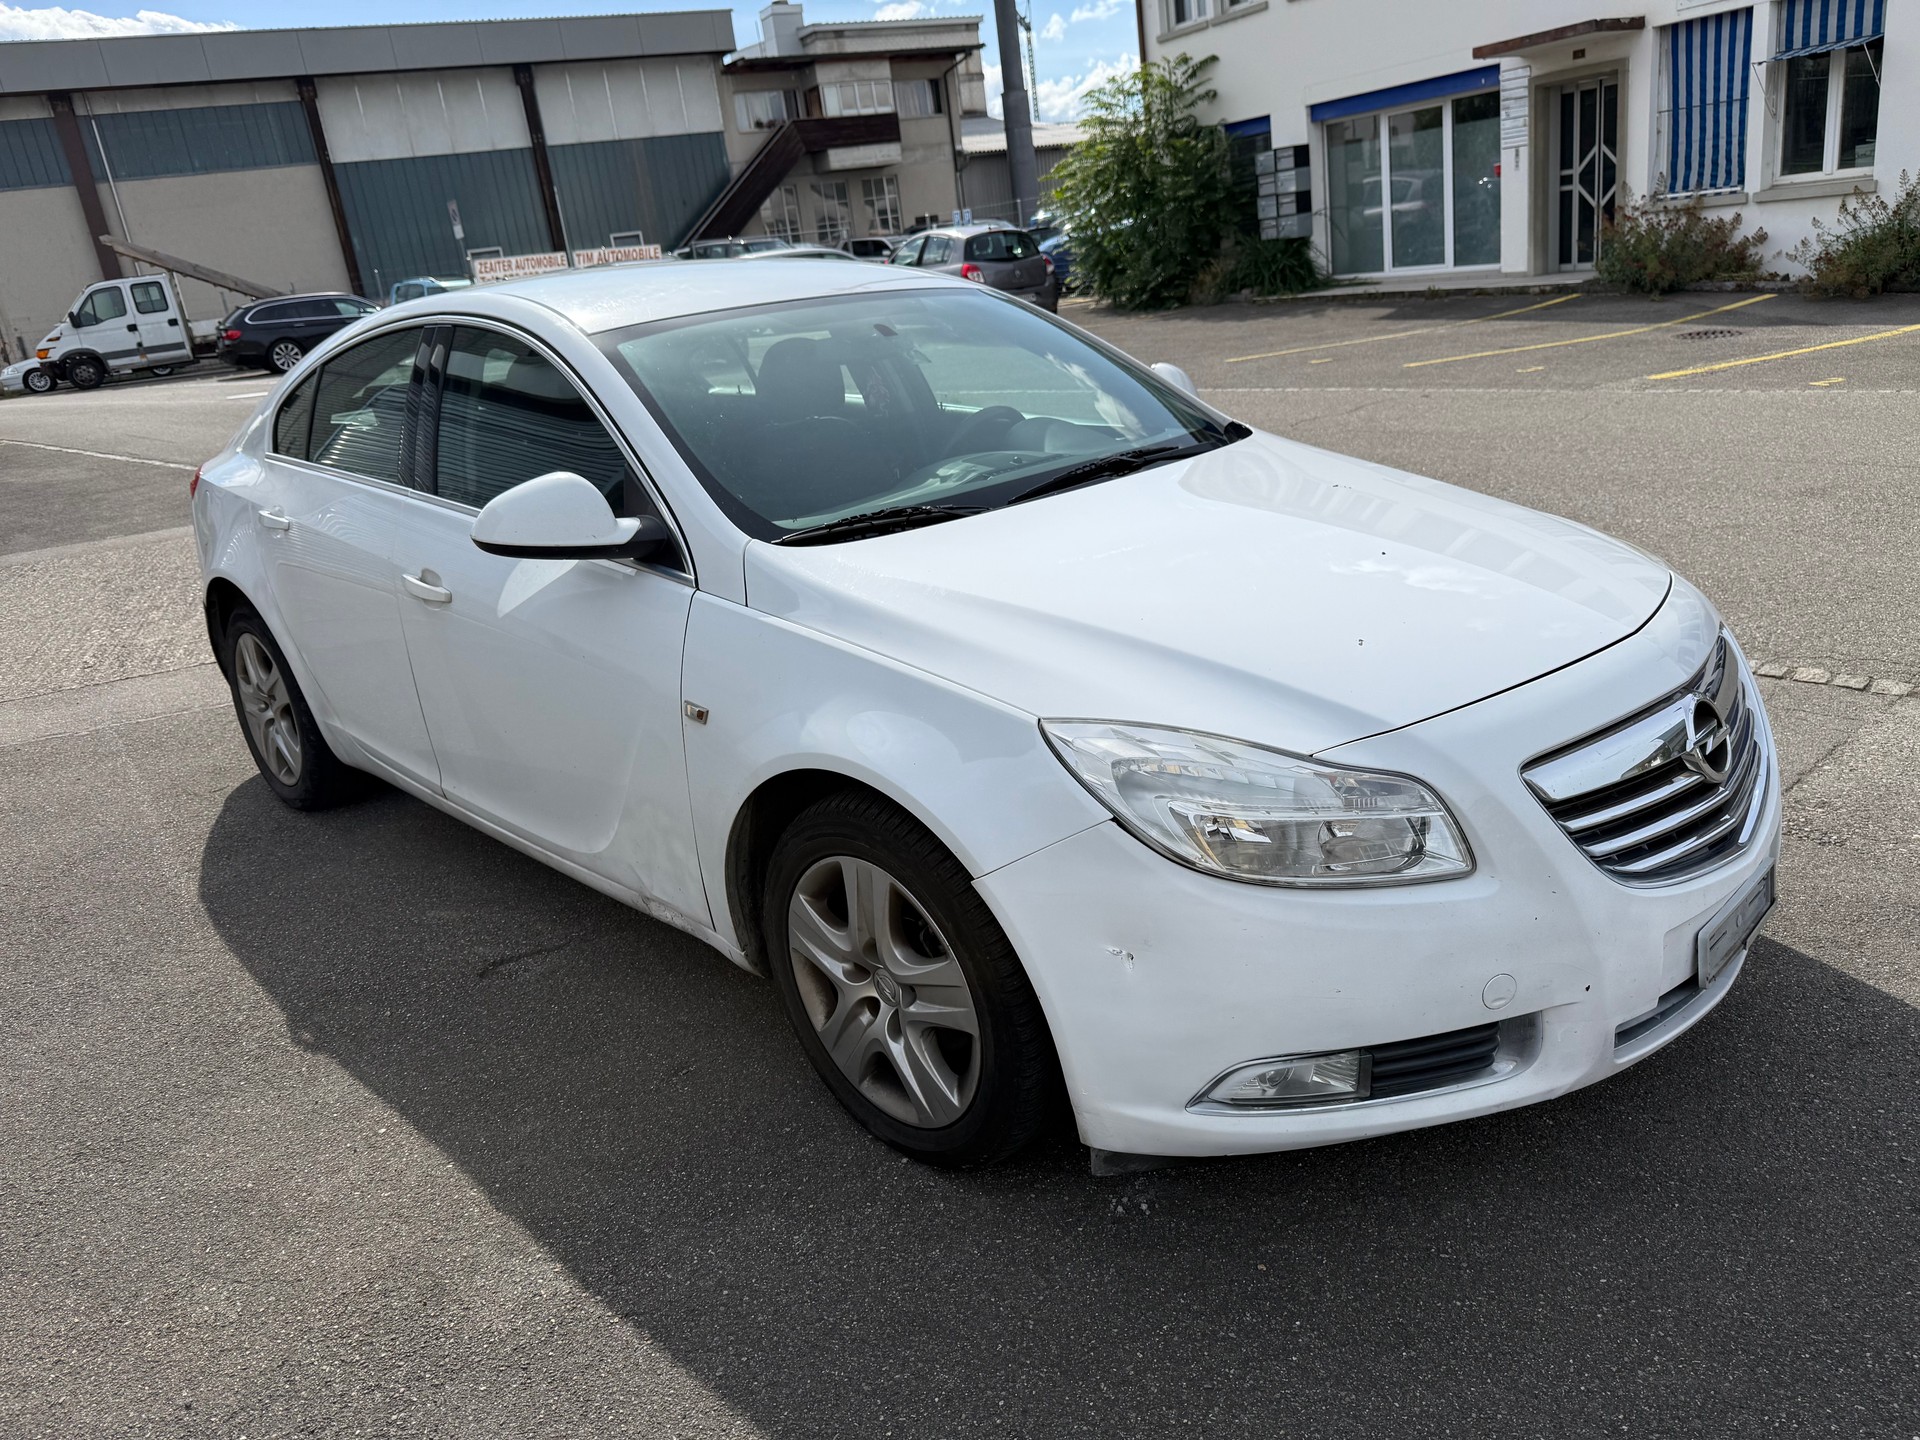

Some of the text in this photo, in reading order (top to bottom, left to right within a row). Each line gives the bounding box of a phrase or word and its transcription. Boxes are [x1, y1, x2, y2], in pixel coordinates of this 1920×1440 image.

[515, 255, 566, 270] AUTOMOBILE
[575, 247, 660, 265] TIM AUTOMOBILE
